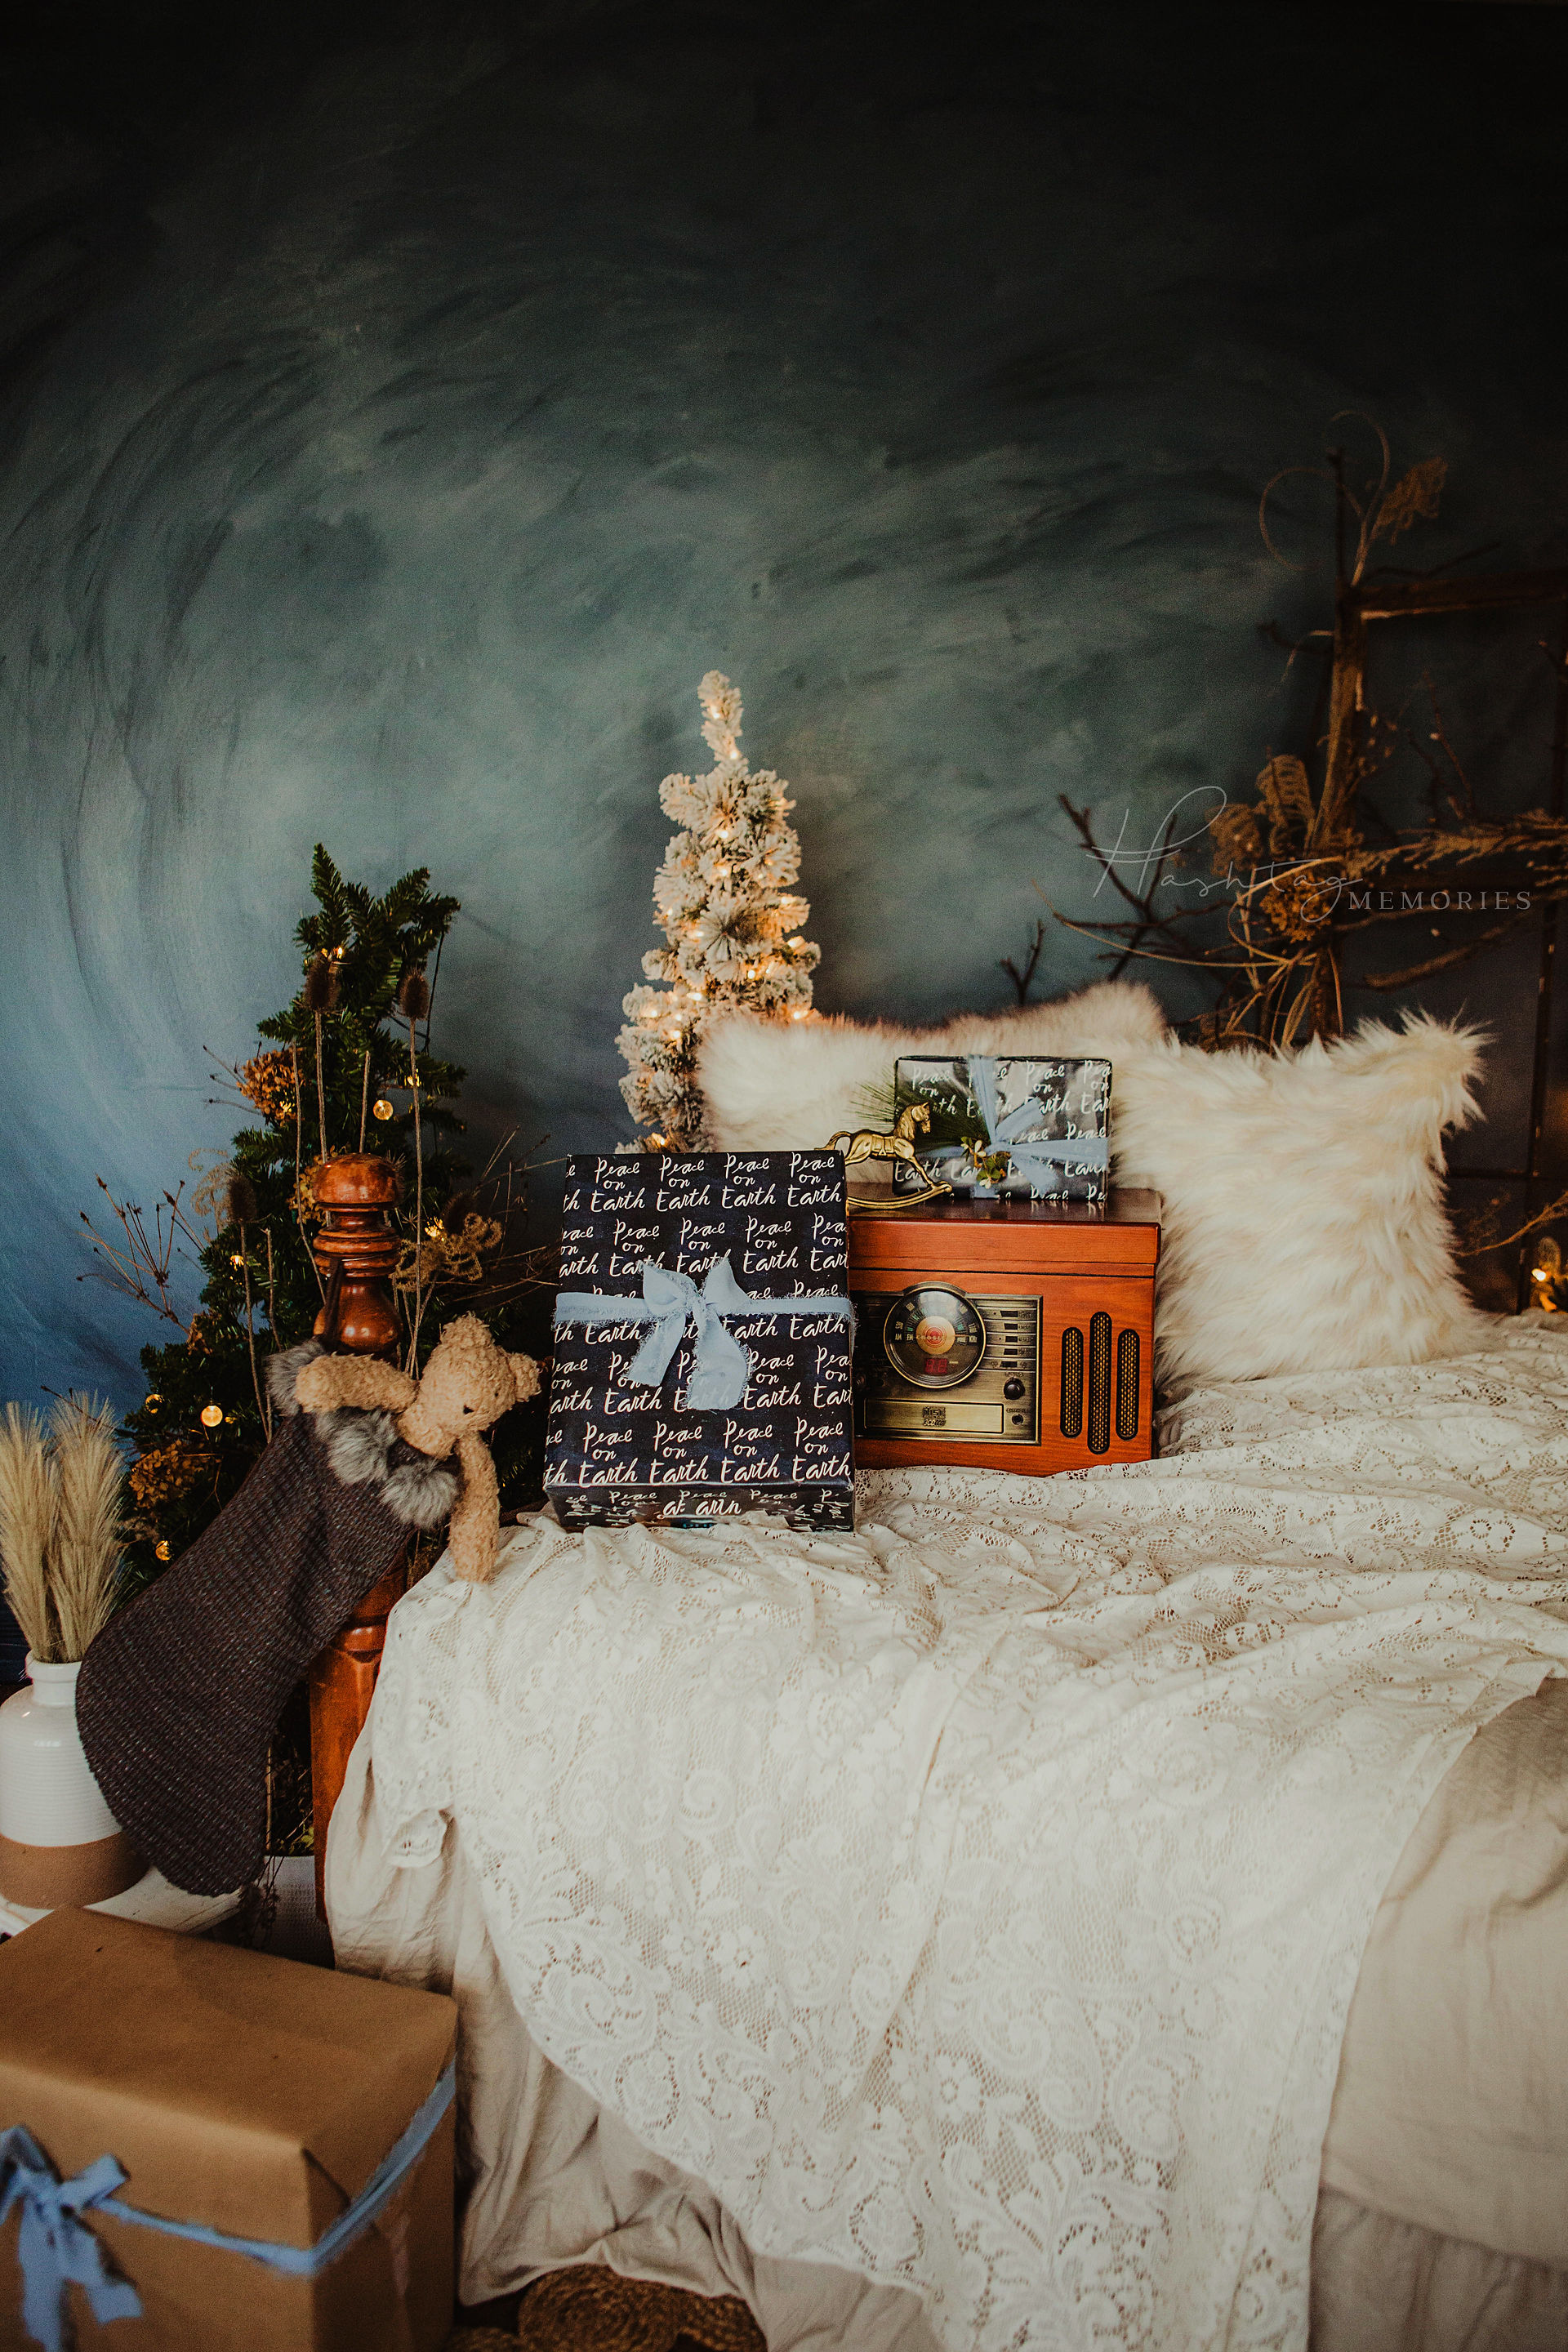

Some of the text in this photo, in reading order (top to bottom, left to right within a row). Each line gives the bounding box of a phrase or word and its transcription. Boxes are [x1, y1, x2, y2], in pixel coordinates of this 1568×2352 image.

[920, 1086, 939, 1098] on
[1033, 1084, 1053, 1094] on
[595, 1156, 640, 1183] Peace
[659, 1154, 705, 1182] Peace
[724, 1152, 770, 1179] Peace
[788, 1152, 835, 1178] Peace
[894, 1156, 942, 1183] Eath
[603, 1179, 626, 1191] on
[668, 1177, 691, 1189] on
[733, 1174, 755, 1186] on
[798, 1174, 821, 1185] on
[590, 1187, 646, 1213] Earth
[656, 1184, 710, 1212] Earth
[721, 1183, 777, 1209] Earth
[787, 1182, 842, 1207] Earth
[561, 1226, 594, 1241] eace
[612, 1218, 660, 1246] Peace
[679, 1216, 726, 1245] Peace
[745, 1214, 792, 1243] Peace
[560, 1245, 579, 1256] on
[621, 1241, 645, 1254] on
[688, 1240, 711, 1251] on
[755, 1238, 777, 1250] on
[822, 1236, 844, 1248] on
[559, 1251, 599, 1279] arth
[743, 1245, 799, 1274] Earth
[810, 1246, 849, 1272] Eart
[585, 1321, 642, 1345] Earth
[789, 1313, 846, 1340] Earth
[551, 1357, 588, 1378] eace
[746, 1348, 795, 1377] Peace
[551, 1379, 572, 1390] on
[755, 1373, 780, 1385] on
[825, 1370, 849, 1383] on
[550, 1386, 594, 1414] arth
[604, 1386, 663, 1415] Earth
[743, 1382, 802, 1411] Earth
[813, 1382, 853, 1408] Eart
[583, 1421, 633, 1454] Peace
[653, 1420, 703, 1452] Peace
[723, 1418, 773, 1449] Peace
[793, 1416, 844, 1447] Peace
[592, 1448, 617, 1462] on
[662, 1446, 688, 1459] on
[733, 1444, 759, 1458] on
[804, 1442, 829, 1455] on
[579, 1457, 639, 1488] Earth
[649, 1454, 709, 1486] Earth
[720, 1453, 781, 1484] Earth
[792, 1451, 852, 1482] Earth
[608, 1490, 657, 1503] Peace
[679, 1489, 728, 1501] Peace
[749, 1489, 798, 1500] Peace
